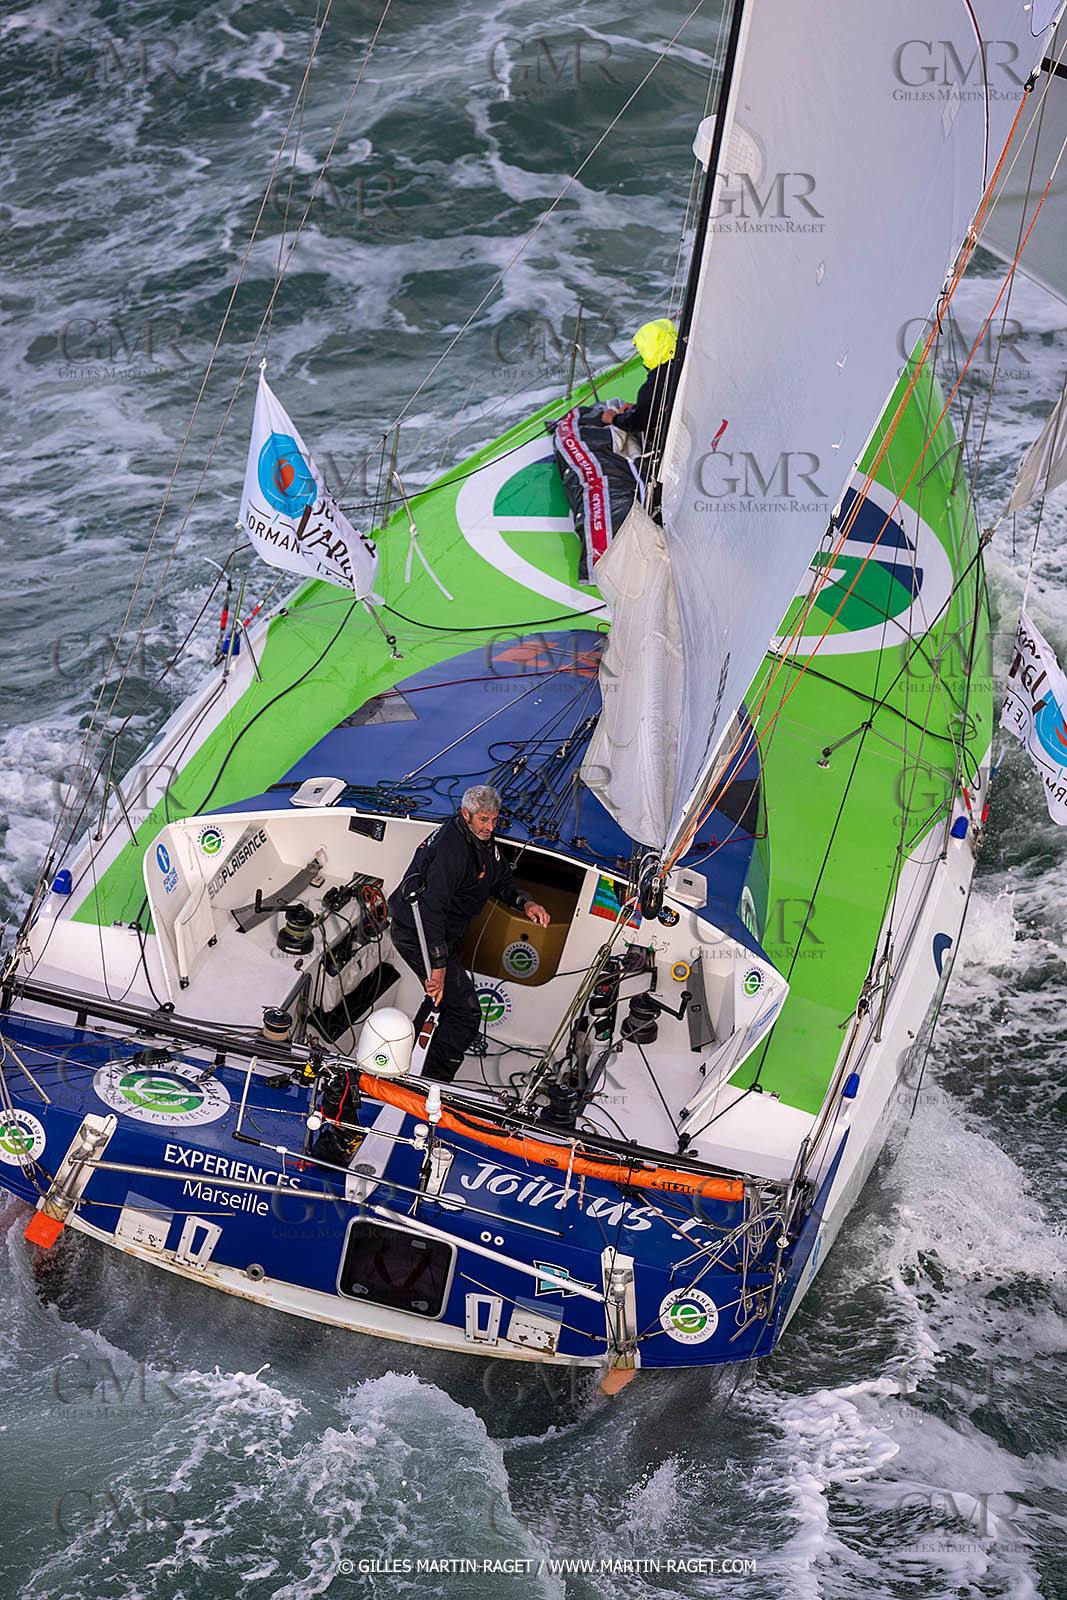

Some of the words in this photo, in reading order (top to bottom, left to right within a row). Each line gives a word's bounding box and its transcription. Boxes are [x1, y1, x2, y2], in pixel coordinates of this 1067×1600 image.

[164, 1144, 301, 1189] EXPERIENCES
[183, 1180, 269, 1216] Marseille
[586, 1197, 664, 1230] us
